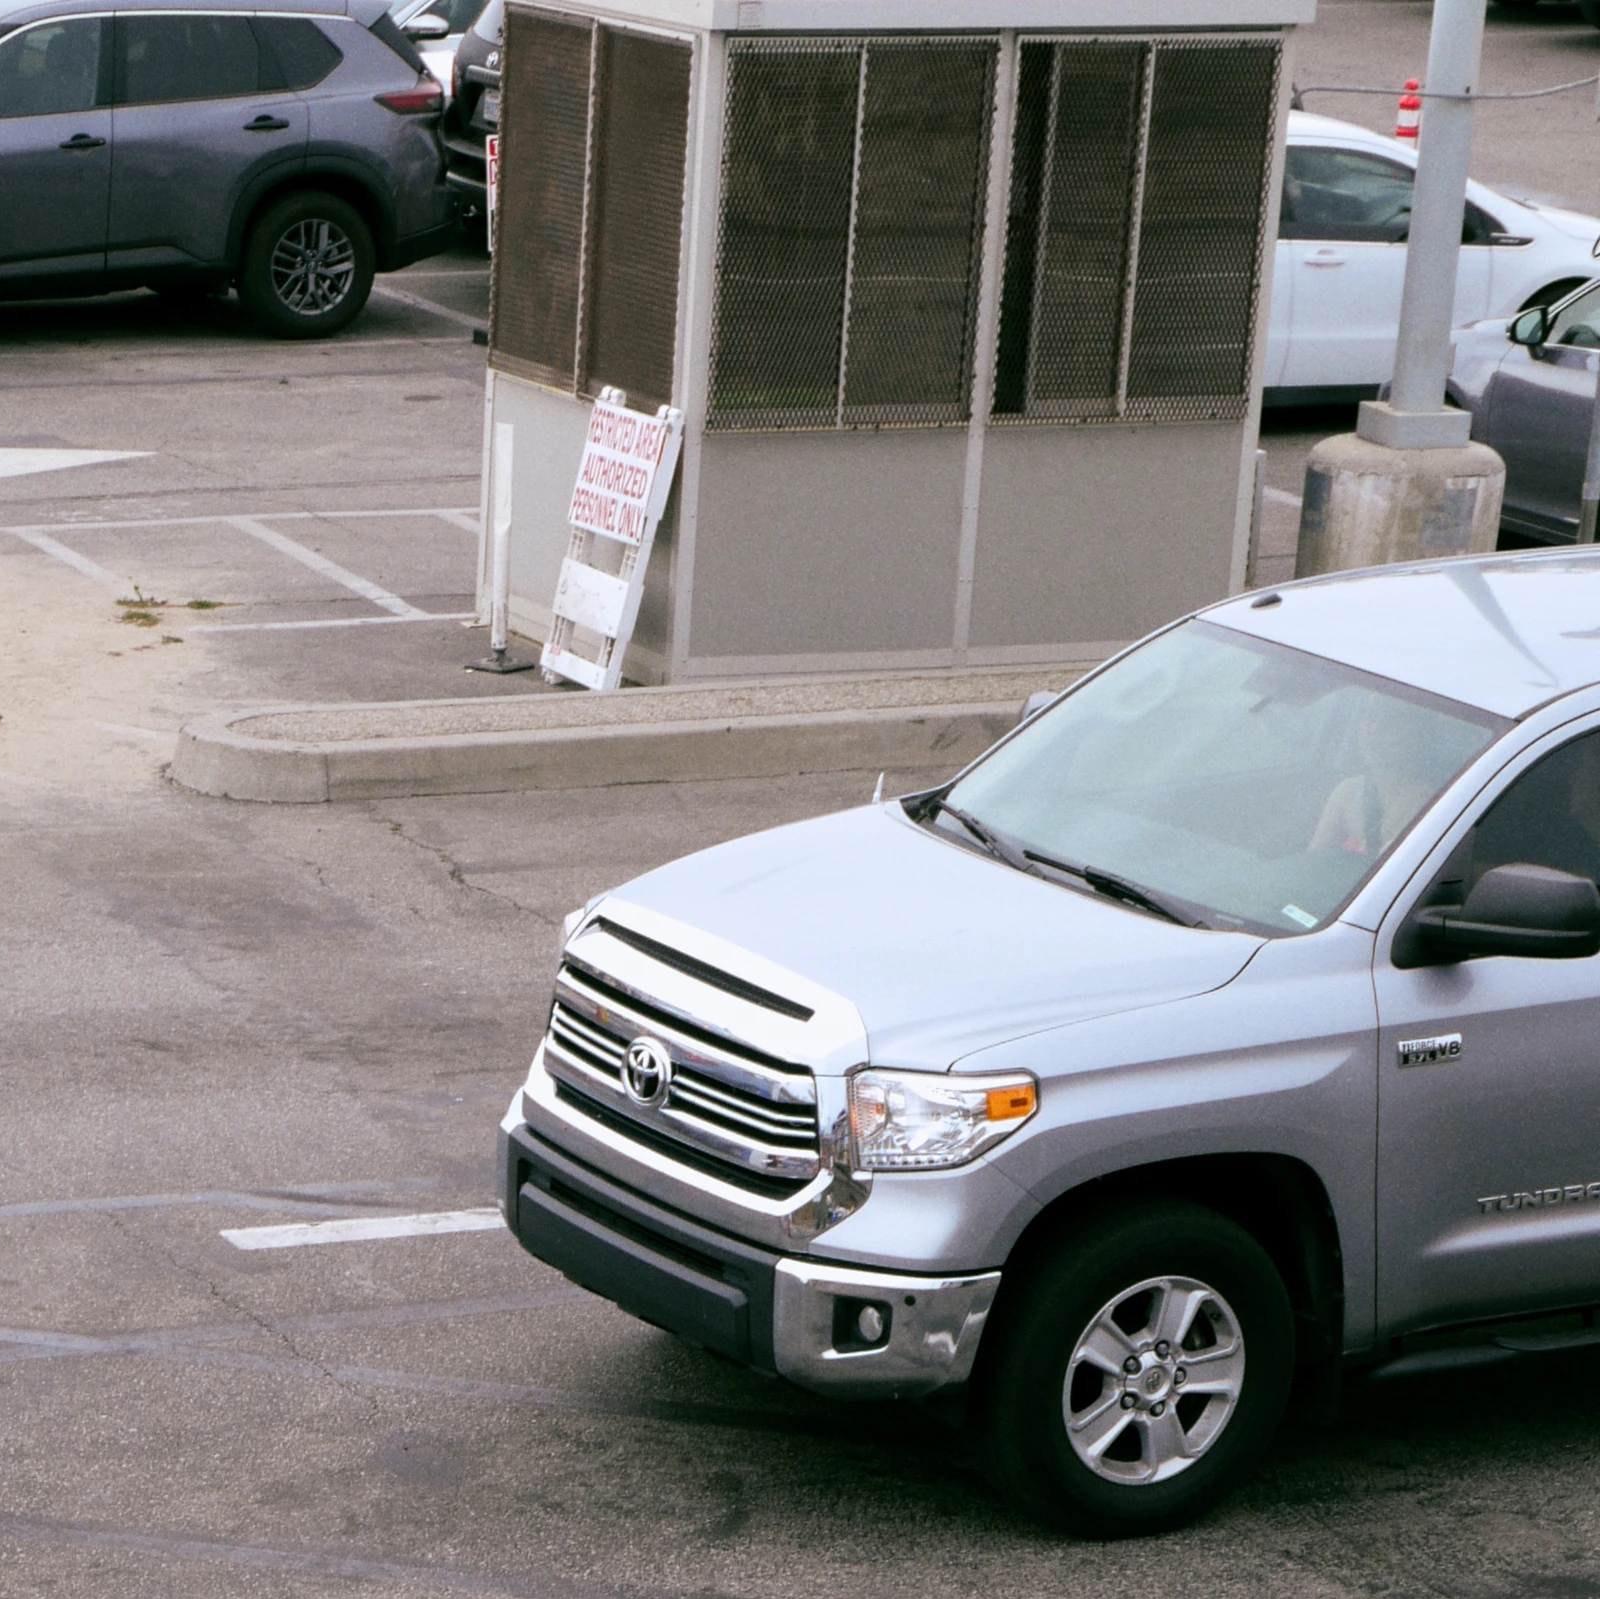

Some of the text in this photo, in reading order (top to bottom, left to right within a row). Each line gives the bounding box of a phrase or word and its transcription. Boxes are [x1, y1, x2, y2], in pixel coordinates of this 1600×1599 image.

[589, 406, 665, 463] RESTRICTED AREA
[581, 452, 649, 500] AUTHORIZED
[572, 486, 644, 539] PERSONNEL ONLY
[1438, 1039, 1461, 1057] V8
